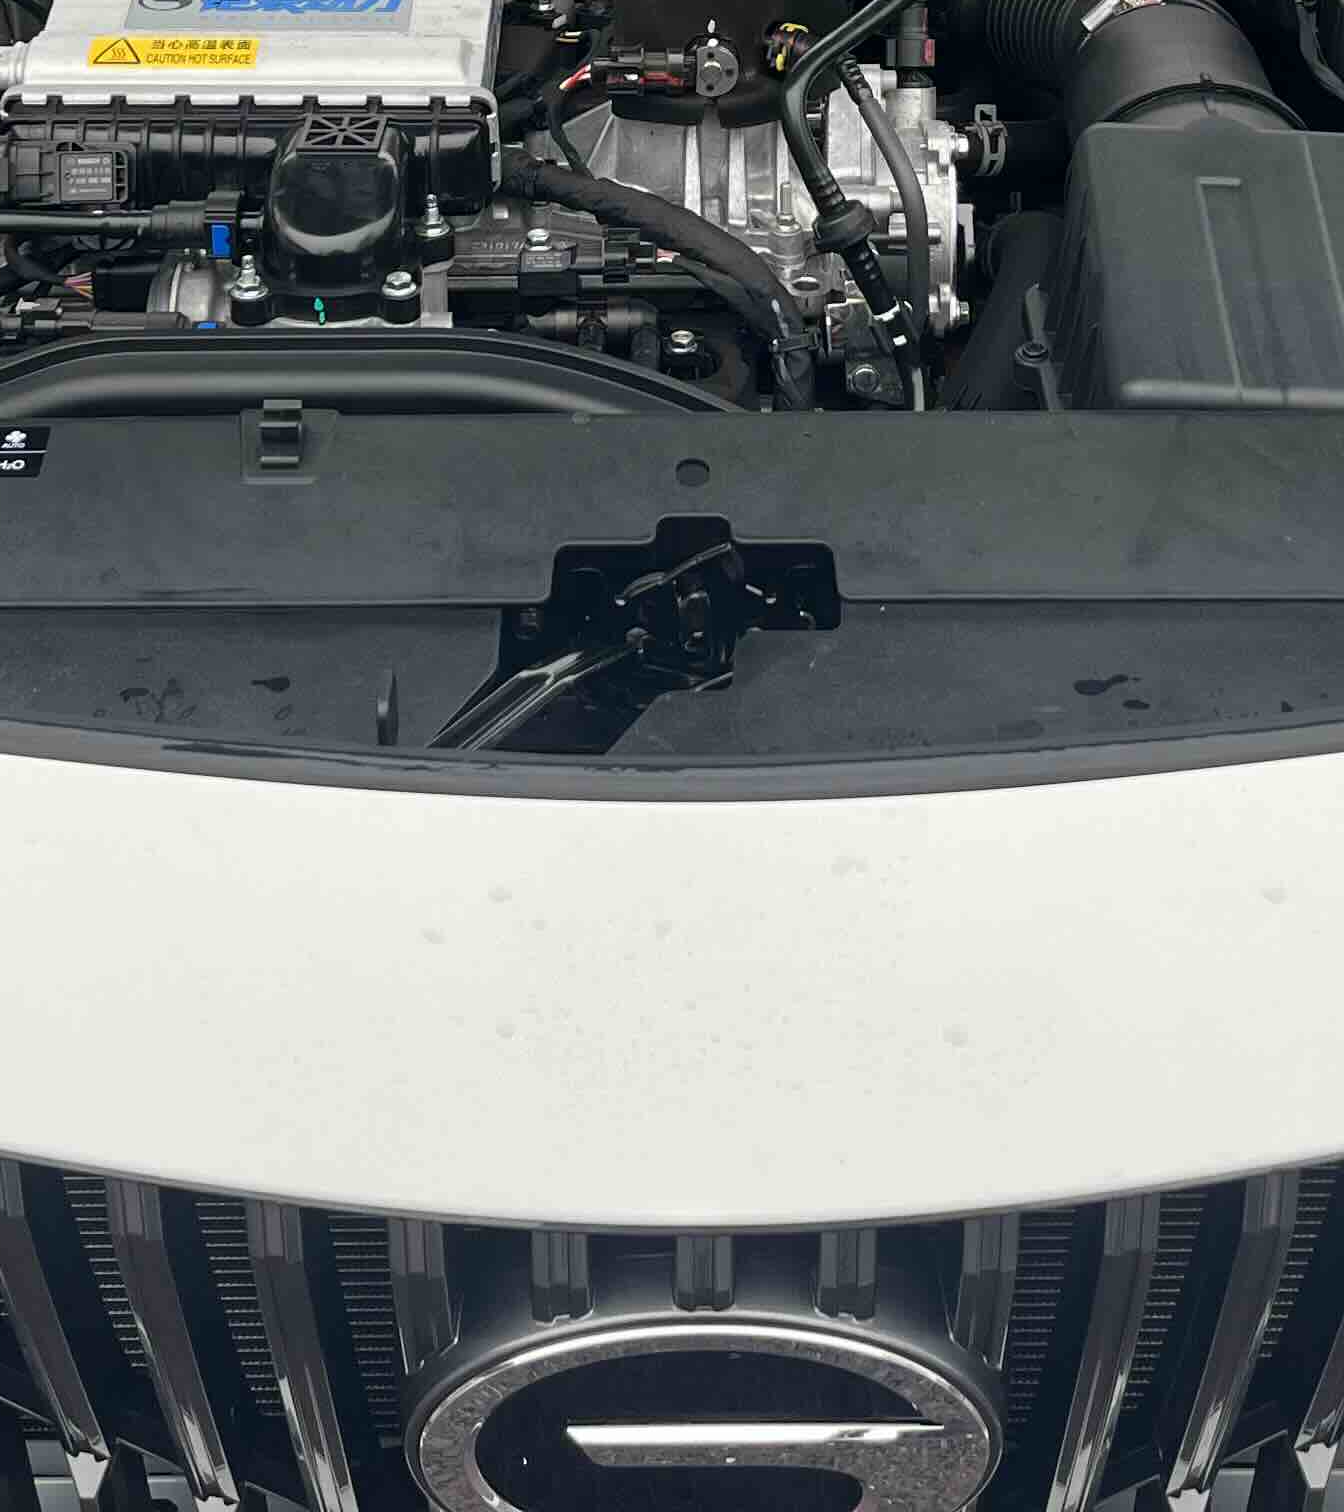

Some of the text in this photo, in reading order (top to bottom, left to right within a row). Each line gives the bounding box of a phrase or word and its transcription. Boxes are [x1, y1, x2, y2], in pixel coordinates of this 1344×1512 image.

[151, 39, 252, 50] 当心高温表面
[146, 53, 252, 65] CAUTION HOT SURFACE
